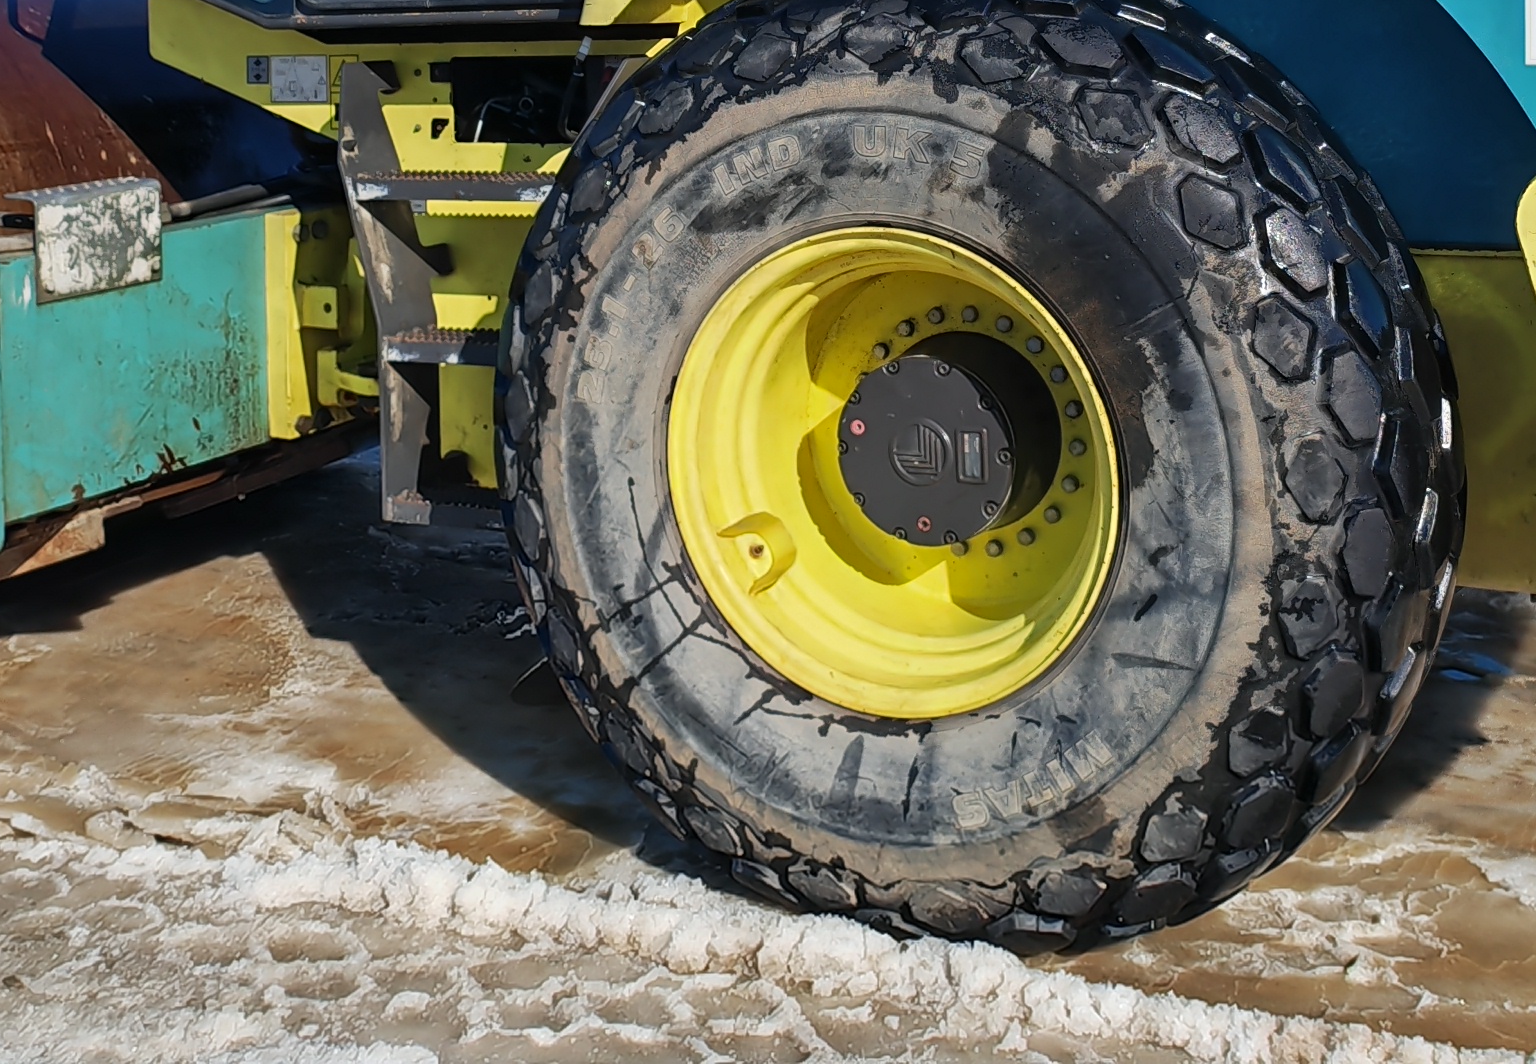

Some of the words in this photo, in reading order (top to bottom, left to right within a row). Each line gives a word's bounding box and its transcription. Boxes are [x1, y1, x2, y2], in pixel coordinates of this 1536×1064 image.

[713, 135, 802, 197] IND
[852, 124, 932, 165] UK
[948, 141, 987, 180] 5
[951, 728, 1114, 831] MITAS
